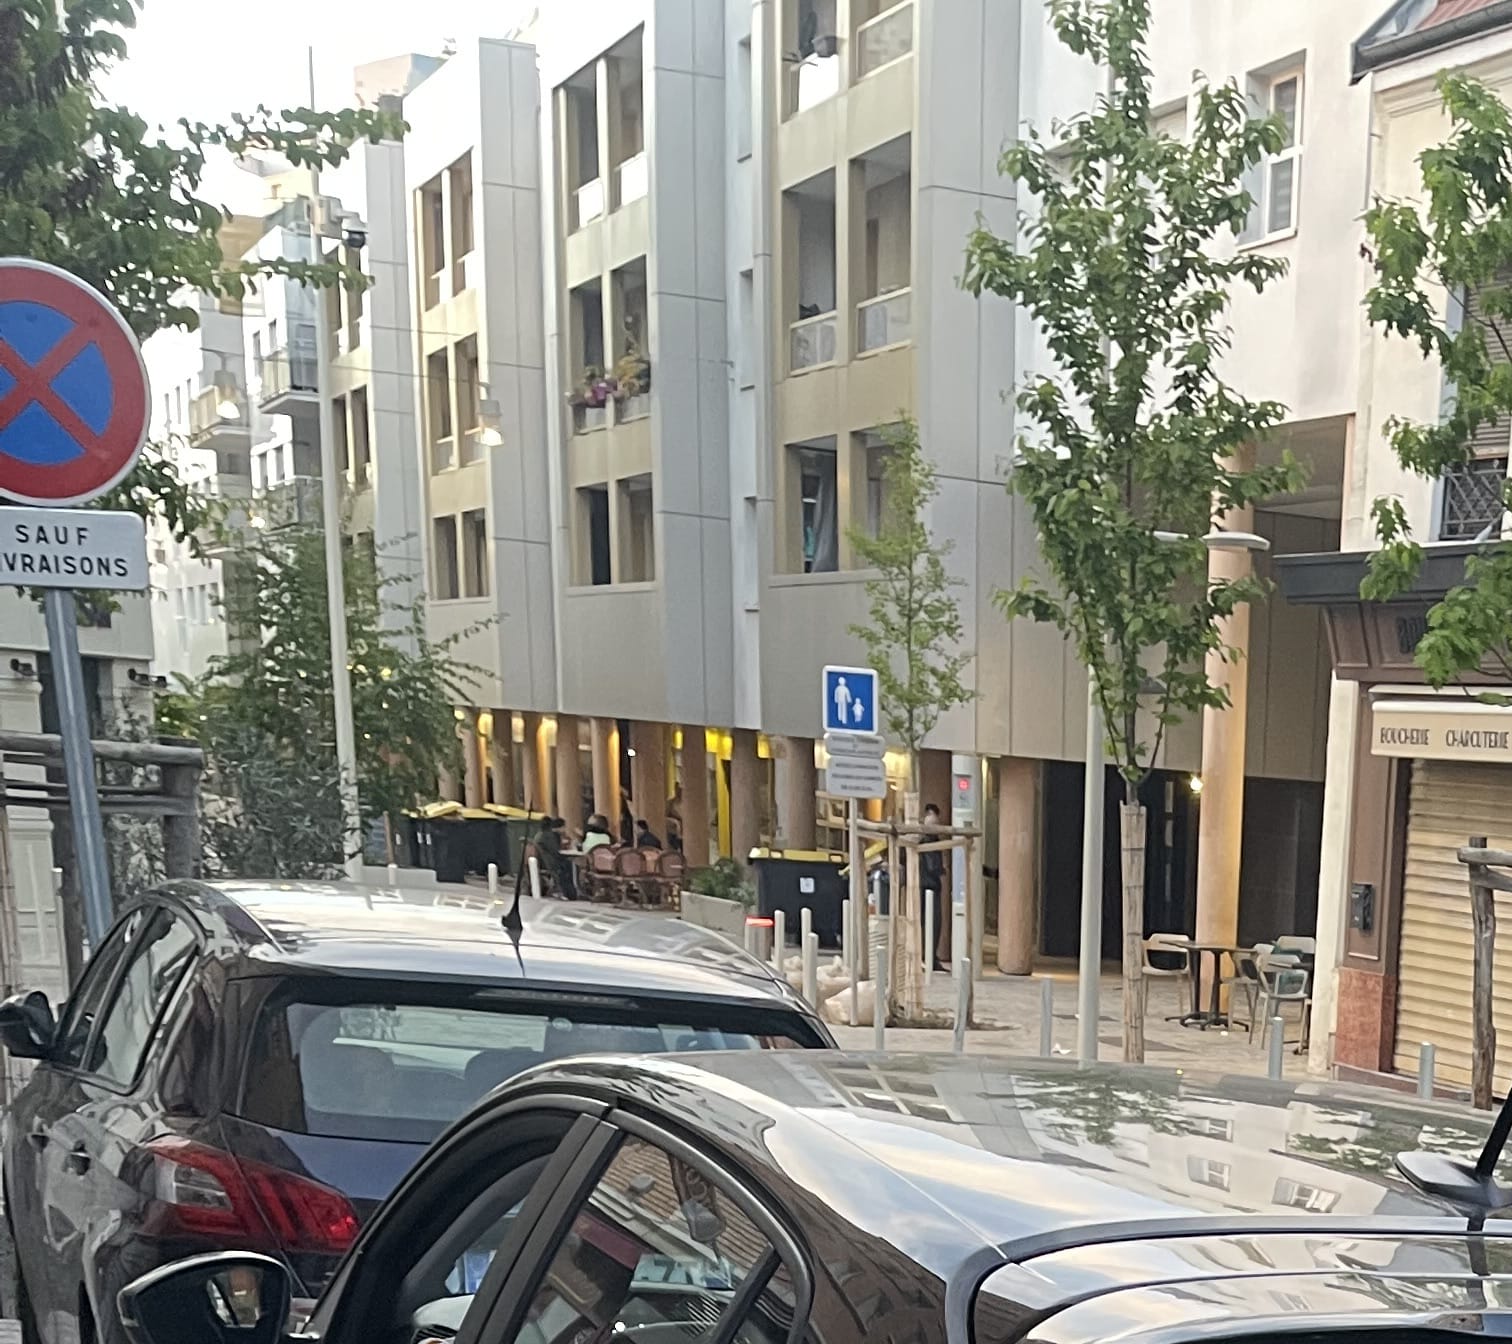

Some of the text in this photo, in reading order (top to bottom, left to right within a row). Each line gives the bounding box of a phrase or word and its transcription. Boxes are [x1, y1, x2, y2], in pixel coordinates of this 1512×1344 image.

[15, 524, 89, 546] SAUF
[0, 552, 128, 577] VRAISONS
[1380, 727, 1430, 747] BOUCHERIE
[1445, 729, 1510, 749] CHARCUTERIE
